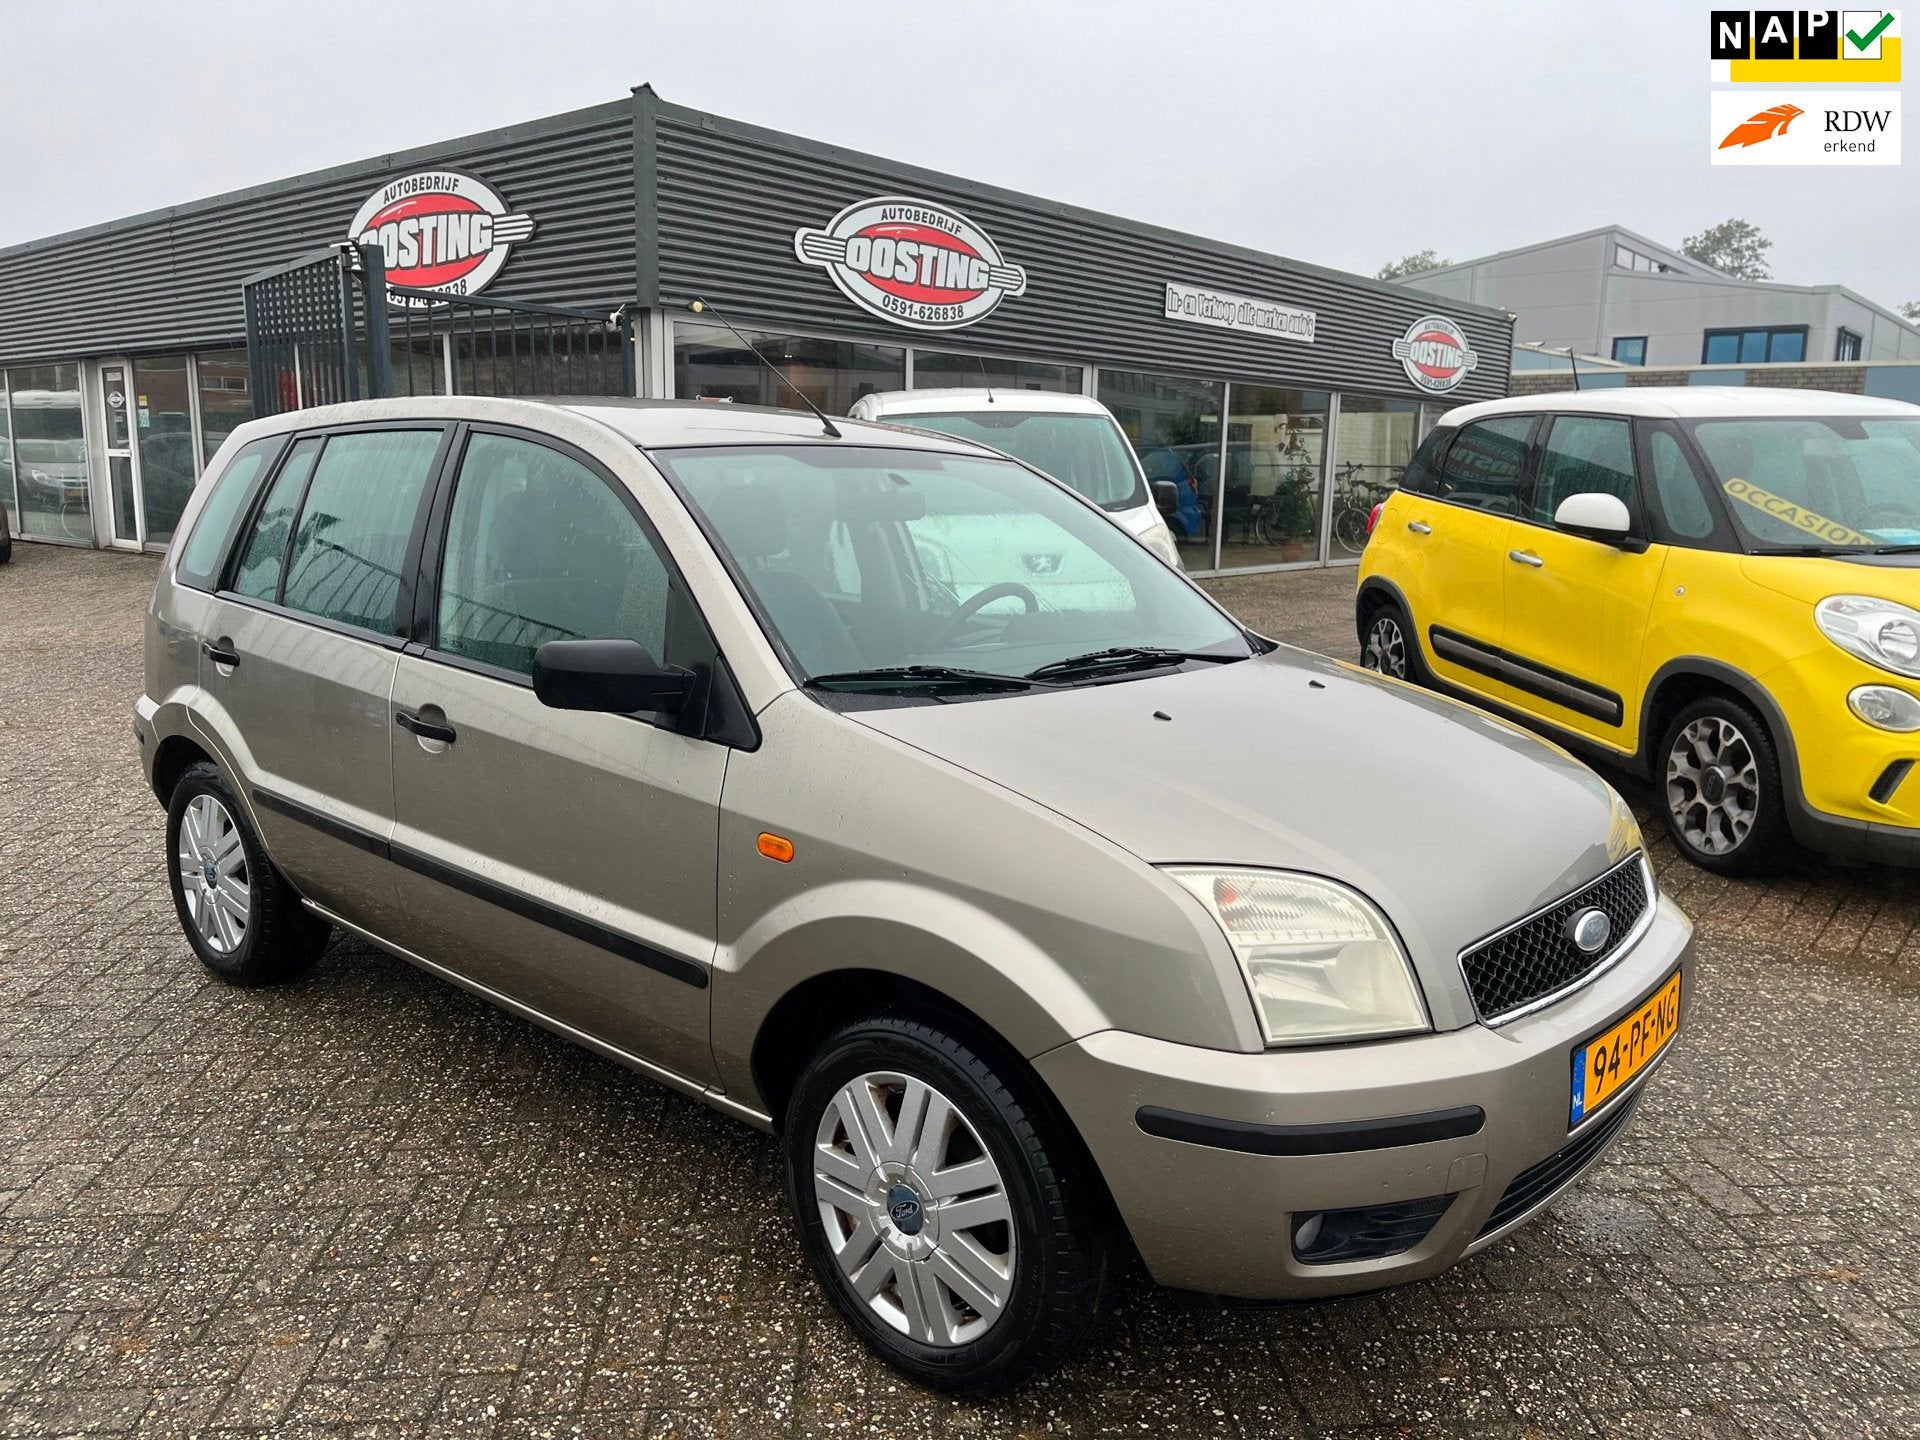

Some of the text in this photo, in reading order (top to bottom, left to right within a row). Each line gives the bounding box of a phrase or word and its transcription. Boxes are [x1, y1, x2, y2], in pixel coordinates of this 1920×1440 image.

[383, 176, 459, 205] AUTOBEDRIJF
[881, 207, 962, 235] AUTOBEDRIJF
[846, 235, 990, 291] OOSTING
[882, 294, 964, 321] 0591-626838
[1184, 294, 1197, 315] en
[1198, 293, 1236, 325] Verkoop
[1238, 302, 1255, 326] alle
[1256, 308, 1288, 332] merken
[1288, 313, 1314, 336] auto's
[1409, 340, 1463, 369] OOSTING
[1593, 985, 1676, 1095] 94-PF-NG
[1572, 1091, 1583, 1110] NL
[895, 1203, 915, 1219] Ford
